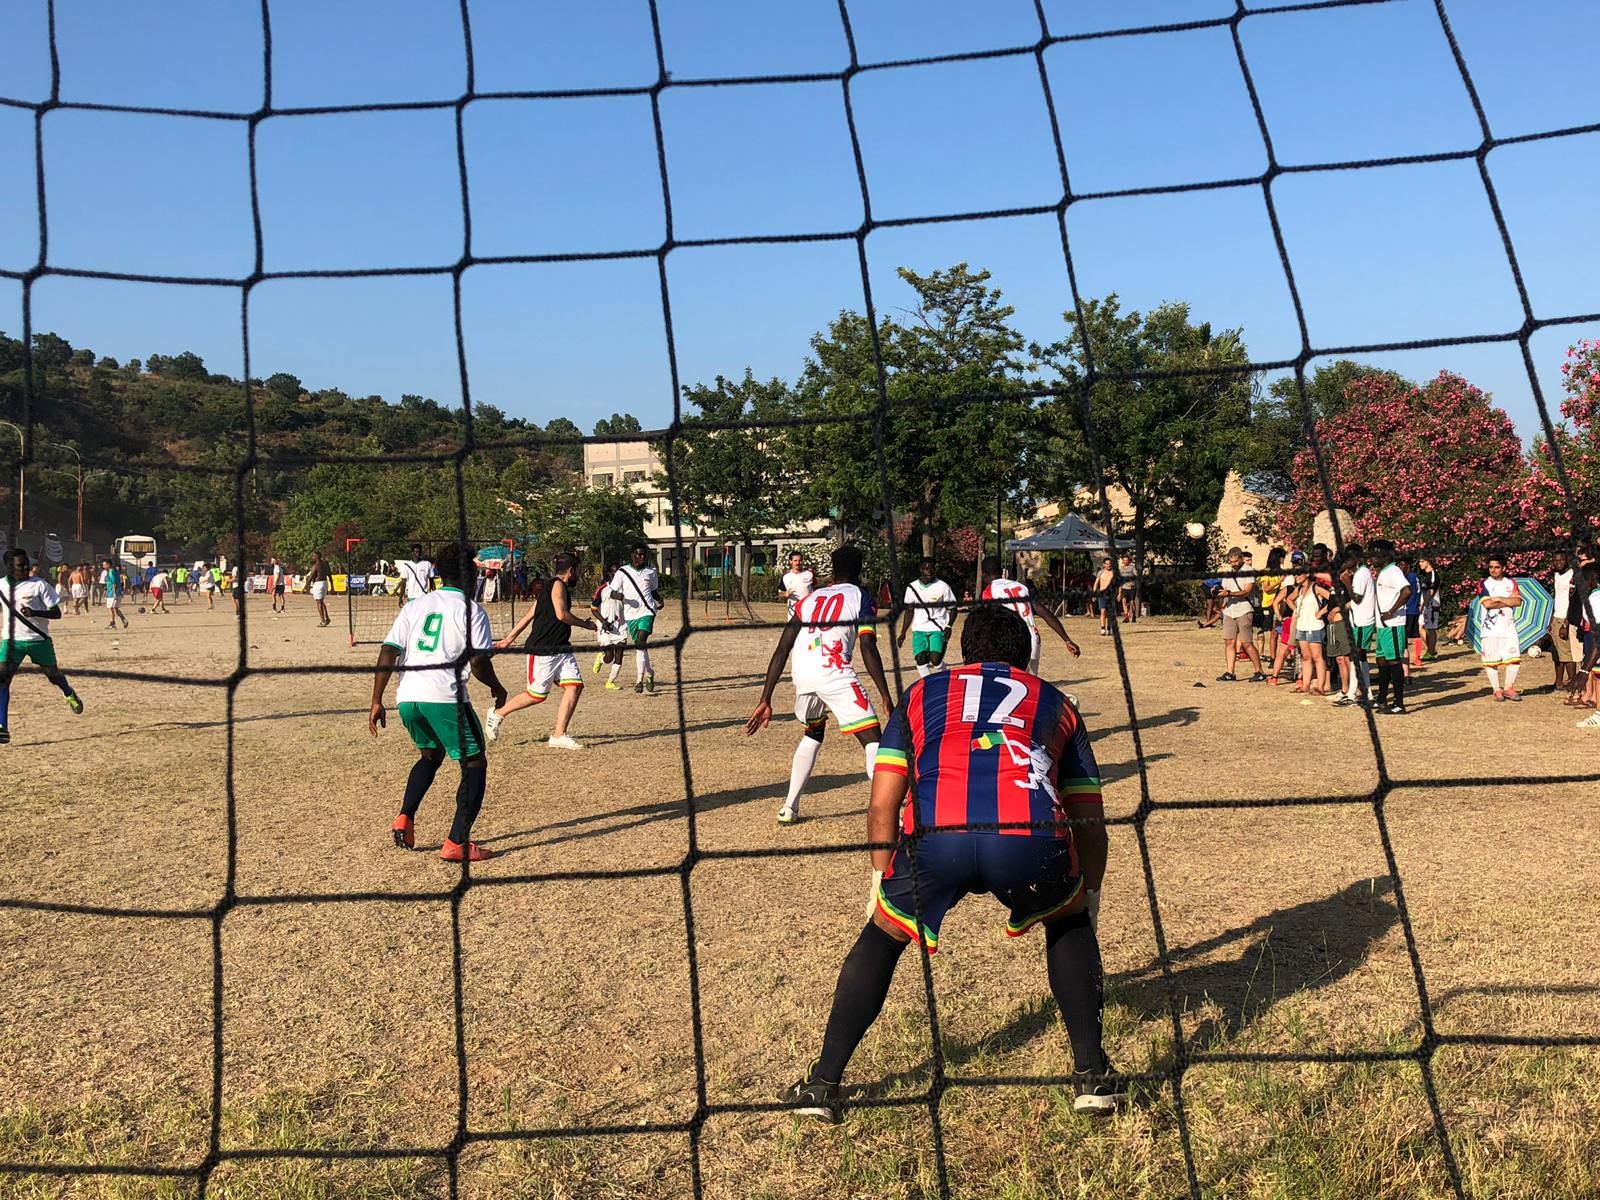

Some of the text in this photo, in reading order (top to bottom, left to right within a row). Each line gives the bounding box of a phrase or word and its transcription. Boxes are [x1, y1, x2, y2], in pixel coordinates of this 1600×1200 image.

[418, 612, 443, 652] 9
[808, 592, 844, 633] 10
[958, 673, 1028, 728] 12
